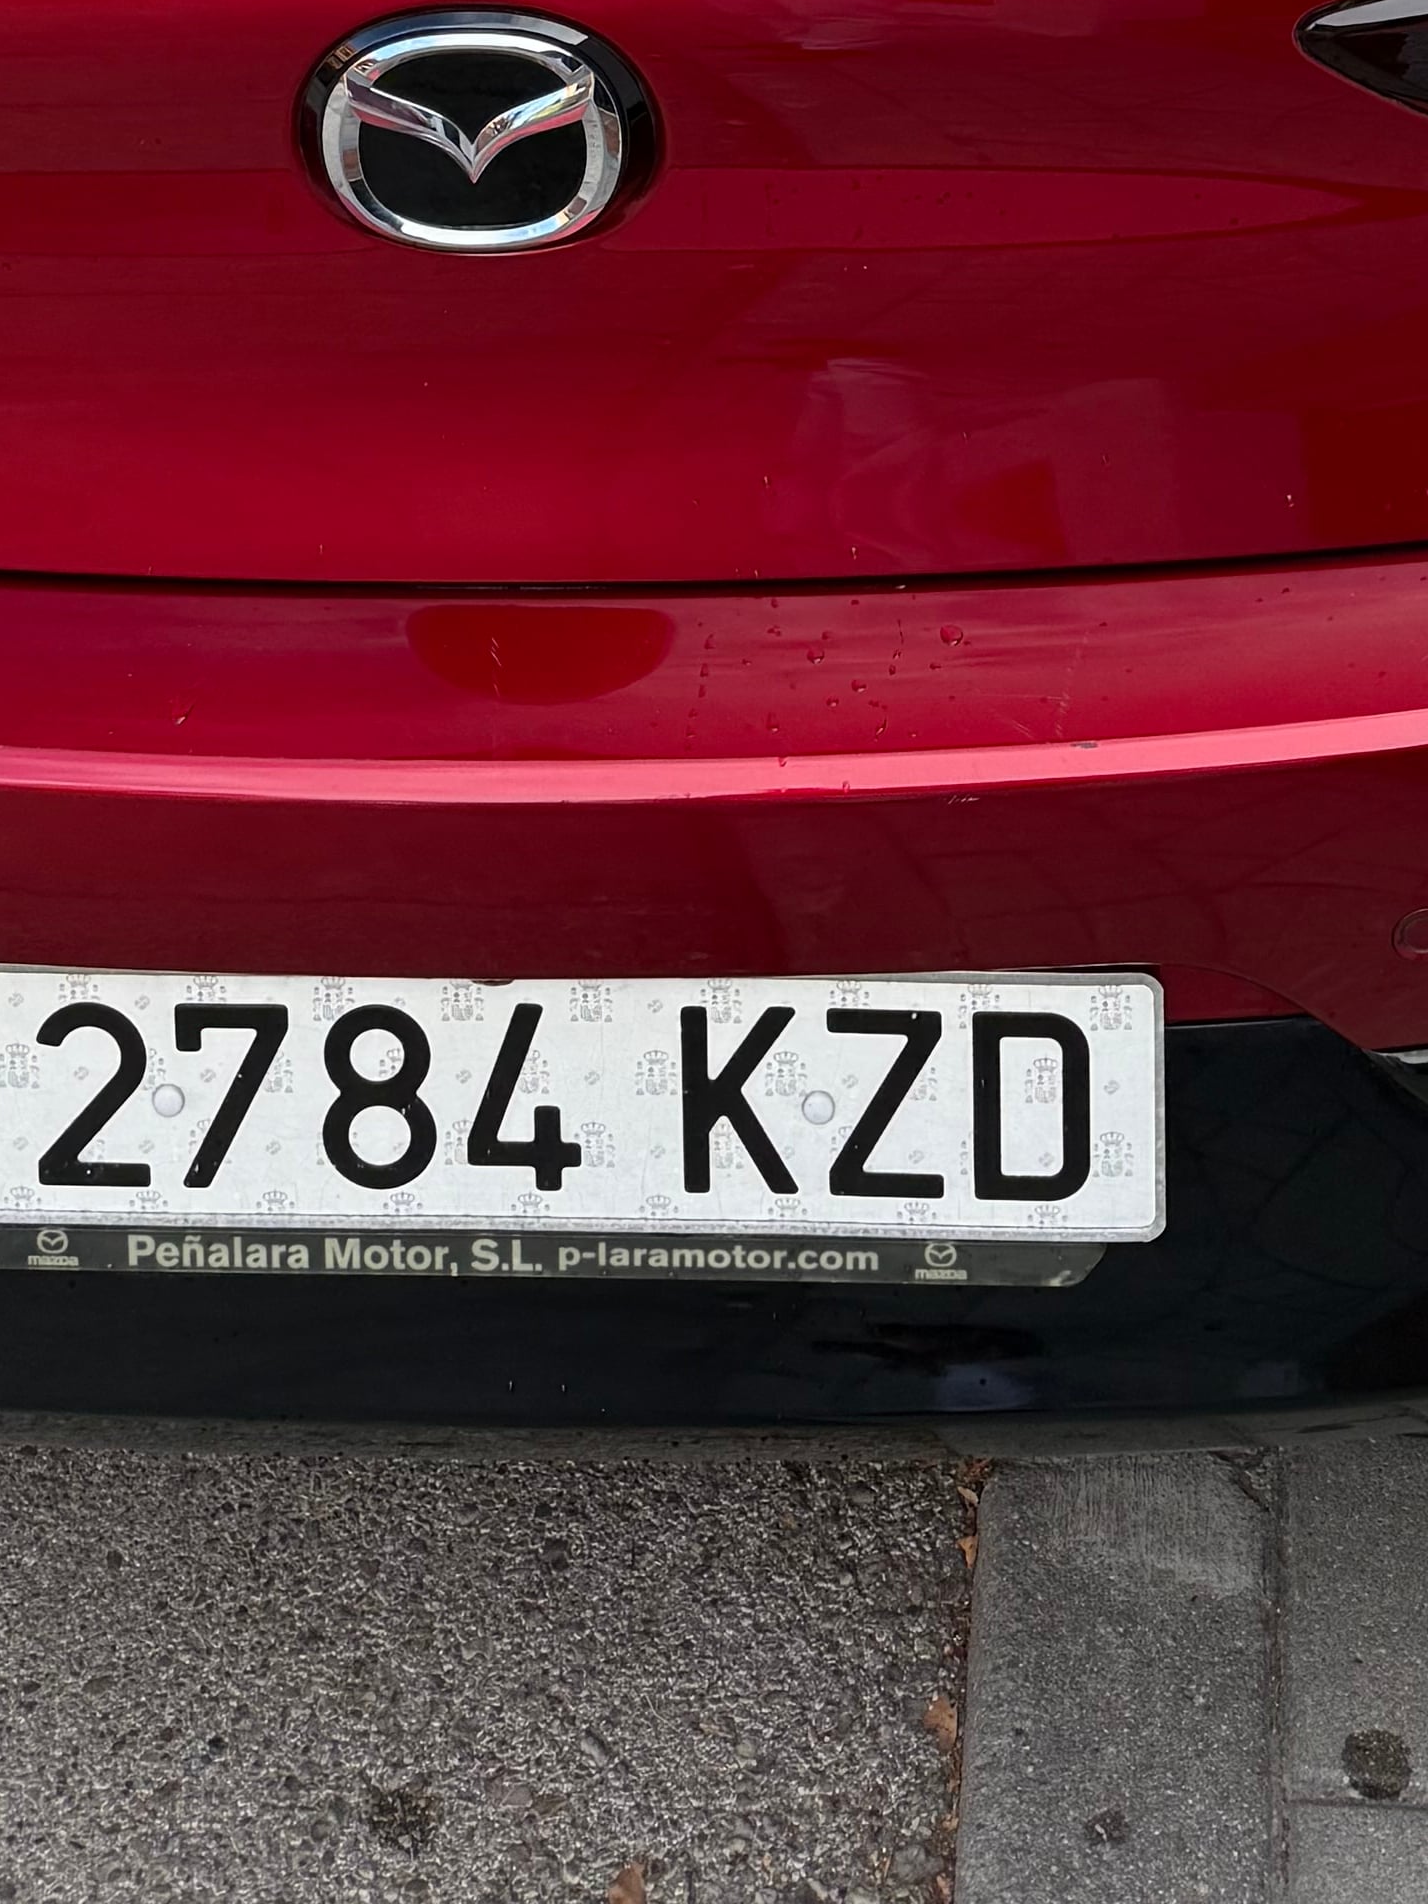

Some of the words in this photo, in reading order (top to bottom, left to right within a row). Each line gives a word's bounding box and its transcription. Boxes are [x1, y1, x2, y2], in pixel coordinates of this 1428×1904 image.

[36, 1002, 582, 1192] 2784
[680, 1005, 1091, 1202] KZD
[127, 1234, 310, 1269] Peñalara
[324, 1237, 458, 1277] Motor,
[471, 1238, 543, 1272] S.L.
[558, 1242, 879, 1272] p-laramotor.com
